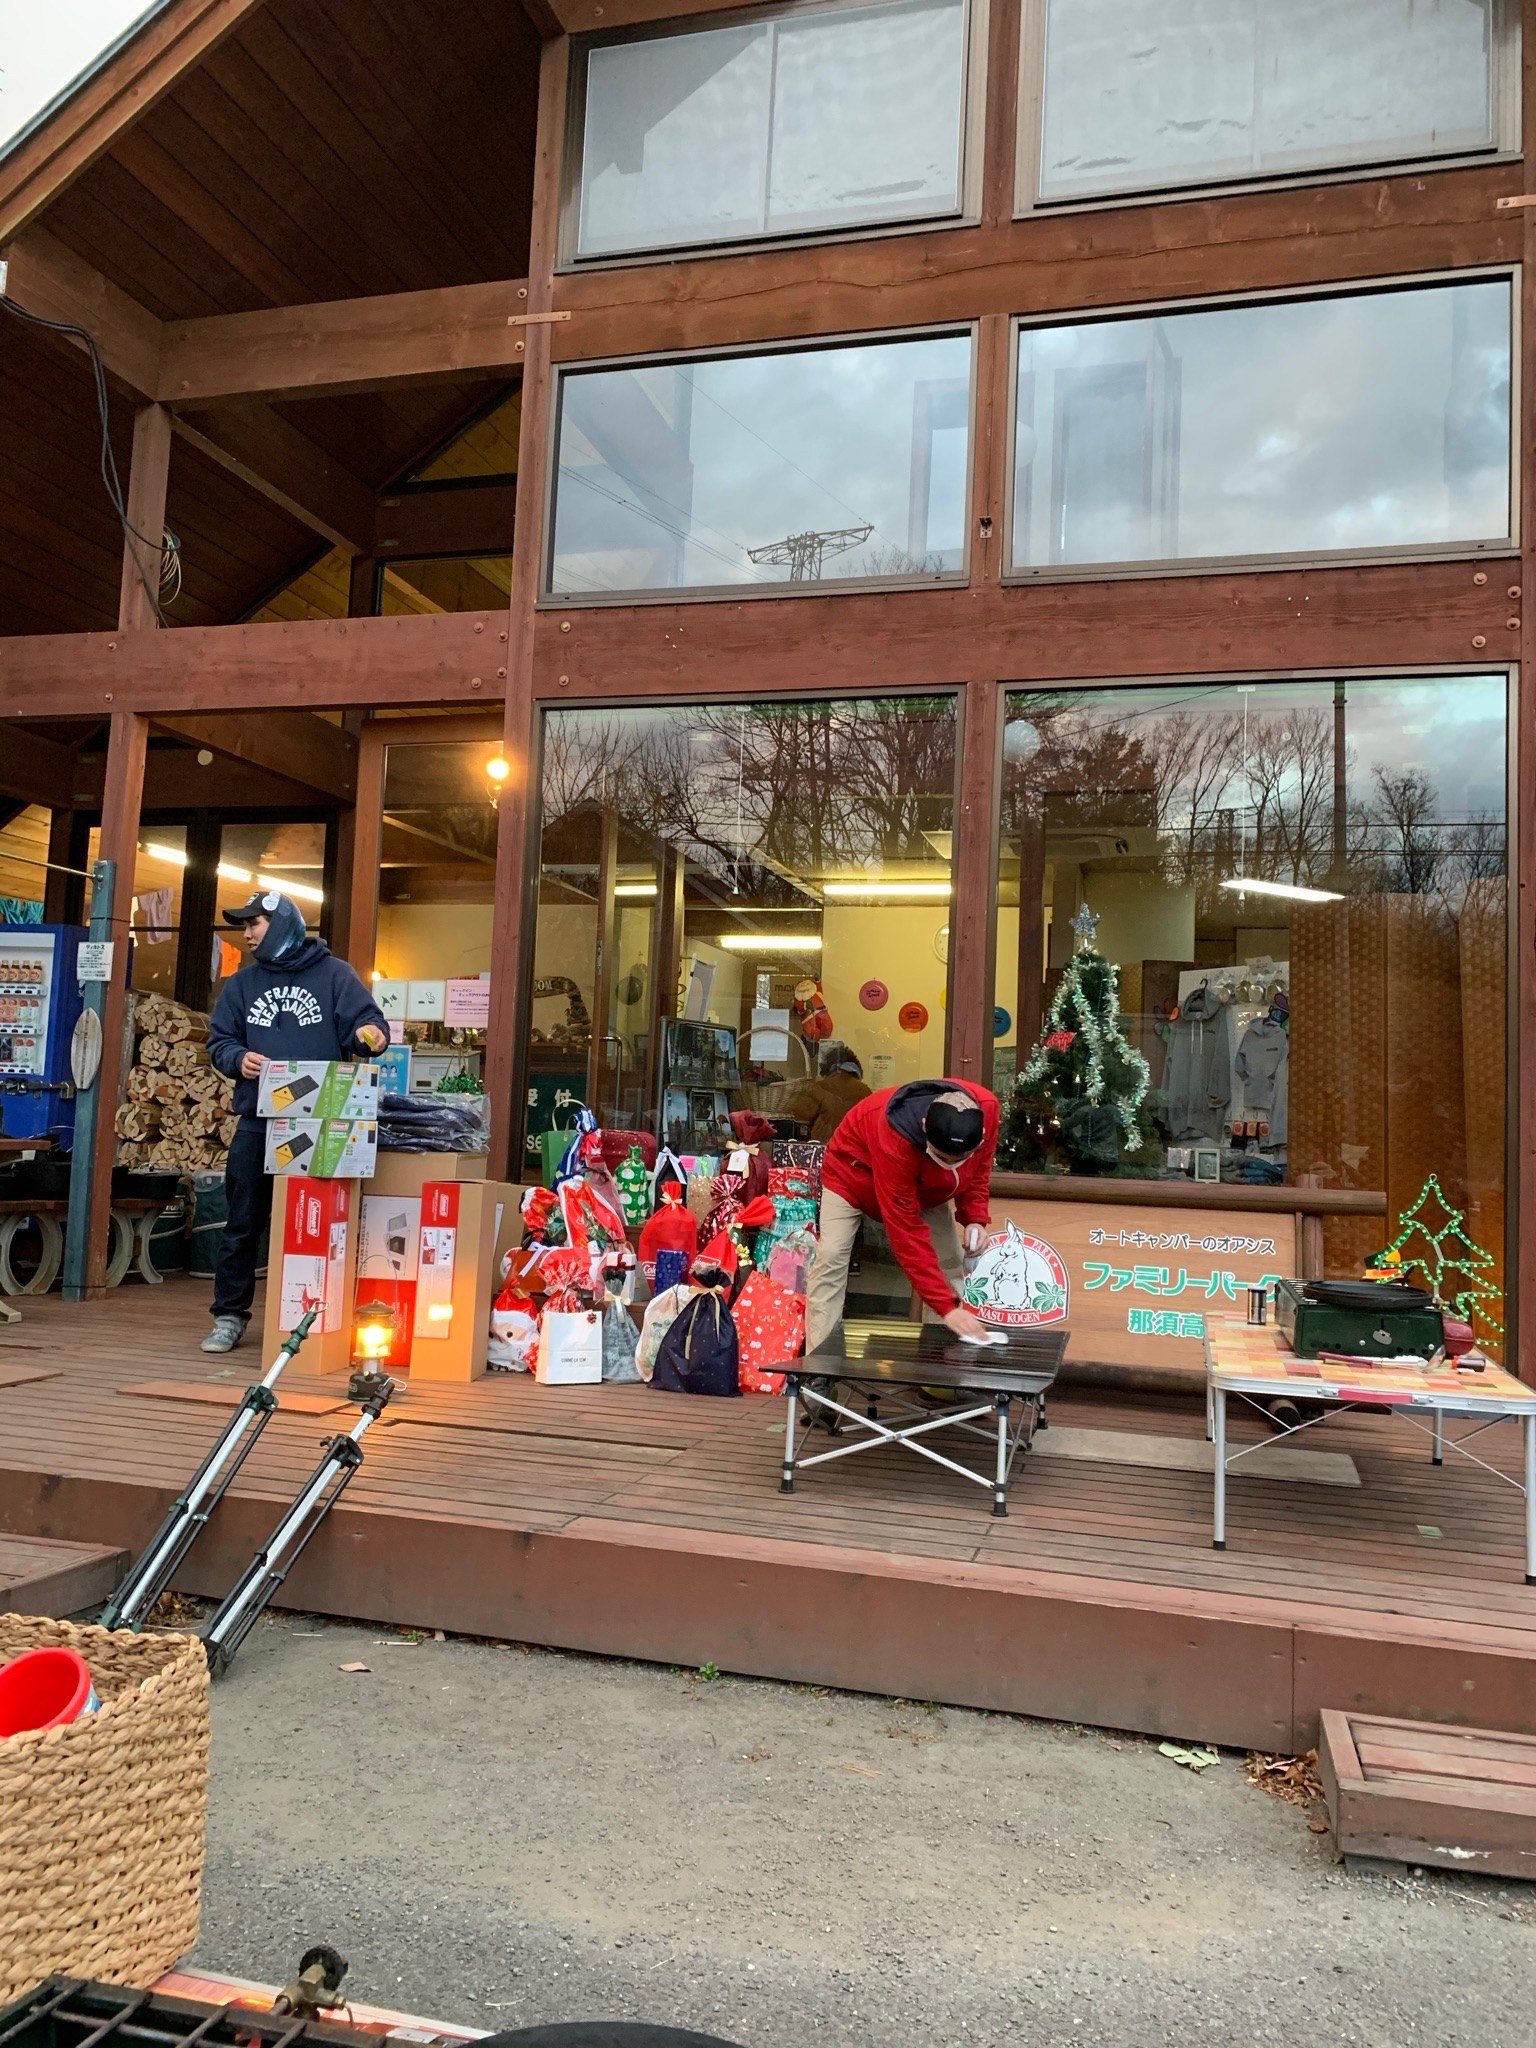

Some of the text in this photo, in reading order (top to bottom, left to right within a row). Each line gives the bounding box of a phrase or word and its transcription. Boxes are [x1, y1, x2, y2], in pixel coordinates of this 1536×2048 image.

[247, 986, 323, 1025] SAN FRANCISCO
[259, 999, 312, 1028] BEN DAVIS
[1031, 1241, 1054, 1260] PARK
[1090, 1229, 1276, 1255] オートキャンパーのオアシス
[977, 1307, 1040, 1324] NASU KOGEN
